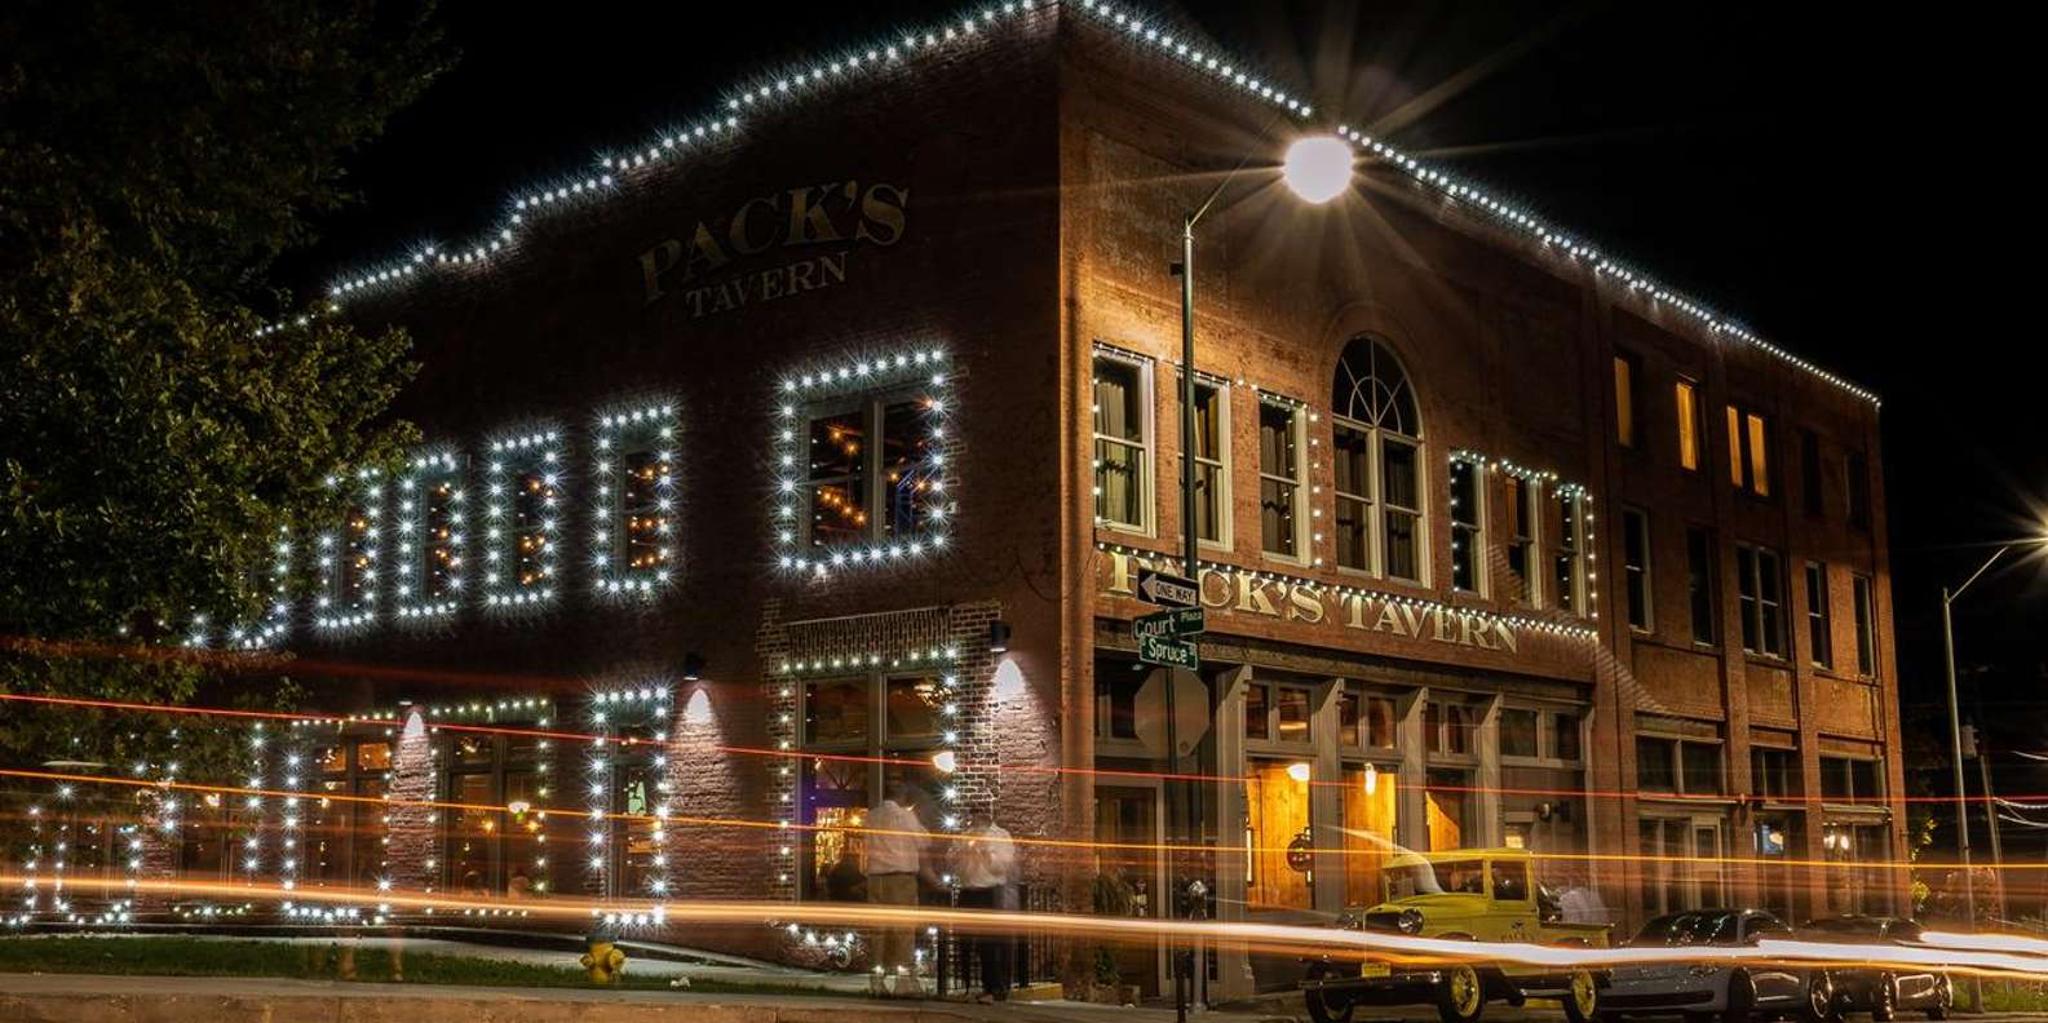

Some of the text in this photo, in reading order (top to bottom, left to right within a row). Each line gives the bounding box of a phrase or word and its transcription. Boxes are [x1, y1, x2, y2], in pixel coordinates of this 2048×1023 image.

[637, 179, 910, 302] PACK'S
[685, 250, 849, 317] TAVERN
[1156, 582, 1194, 605] ONE WAY
[1135, 614, 1176, 638] Court
[1338, 591, 1518, 654] TAVERN
[1148, 638, 1188, 664] Spruce
